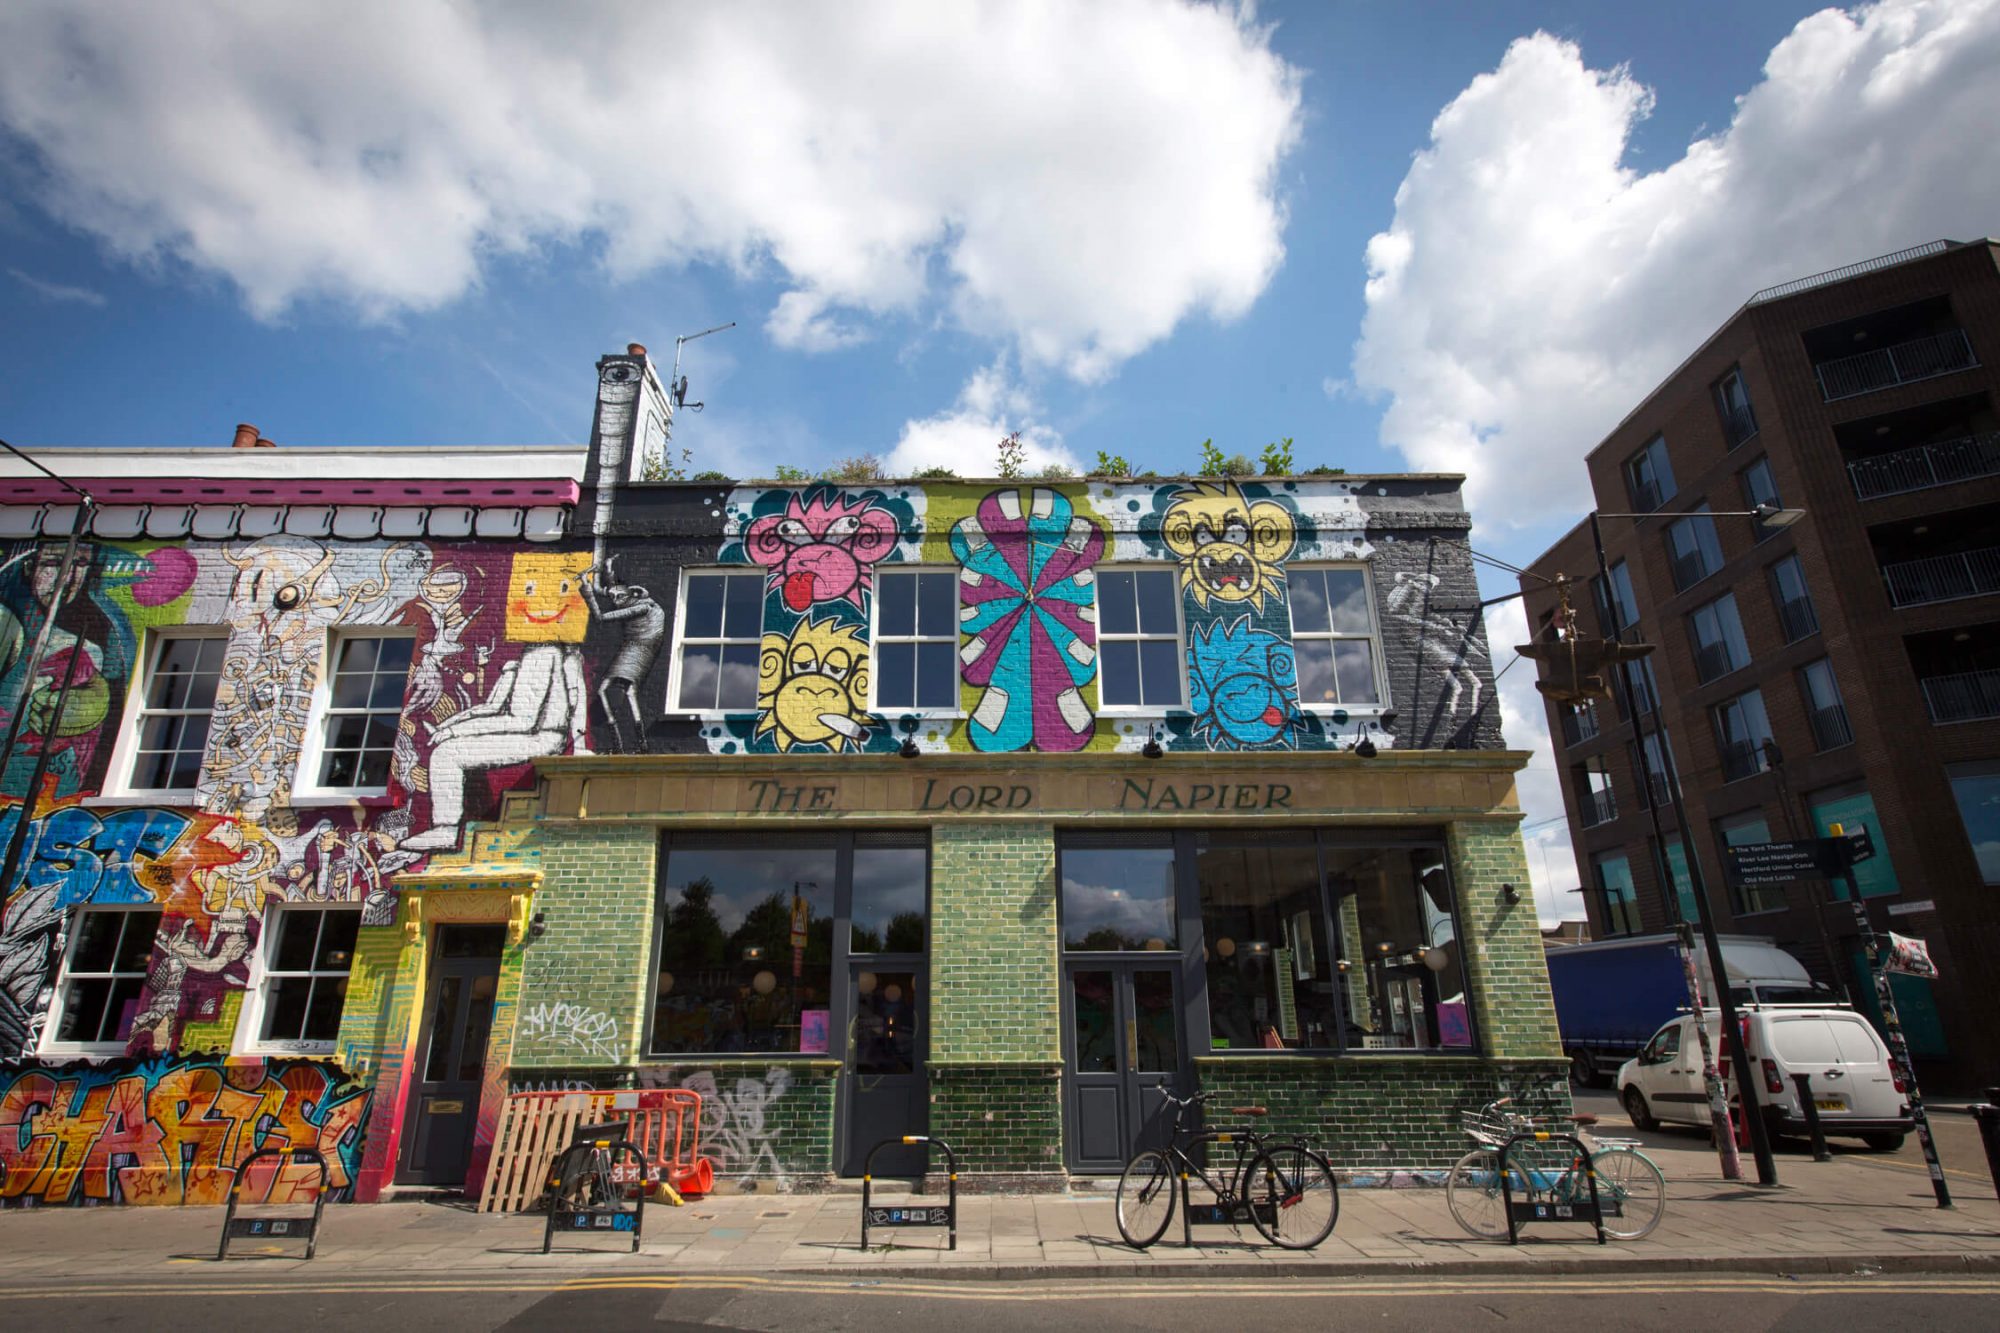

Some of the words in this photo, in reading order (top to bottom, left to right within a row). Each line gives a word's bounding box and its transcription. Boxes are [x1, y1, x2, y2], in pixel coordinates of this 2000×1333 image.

[747, 780, 836, 811] THE
[919, 779, 1033, 811] LORD
[1119, 778, 1293, 810] NAPIER
[1766, 843, 1793, 851] Theatre
[1771, 853, 1809, 861] Navigation
[1741, 865, 1771, 873] Hertford
[1744, 876, 1757, 884] Old
